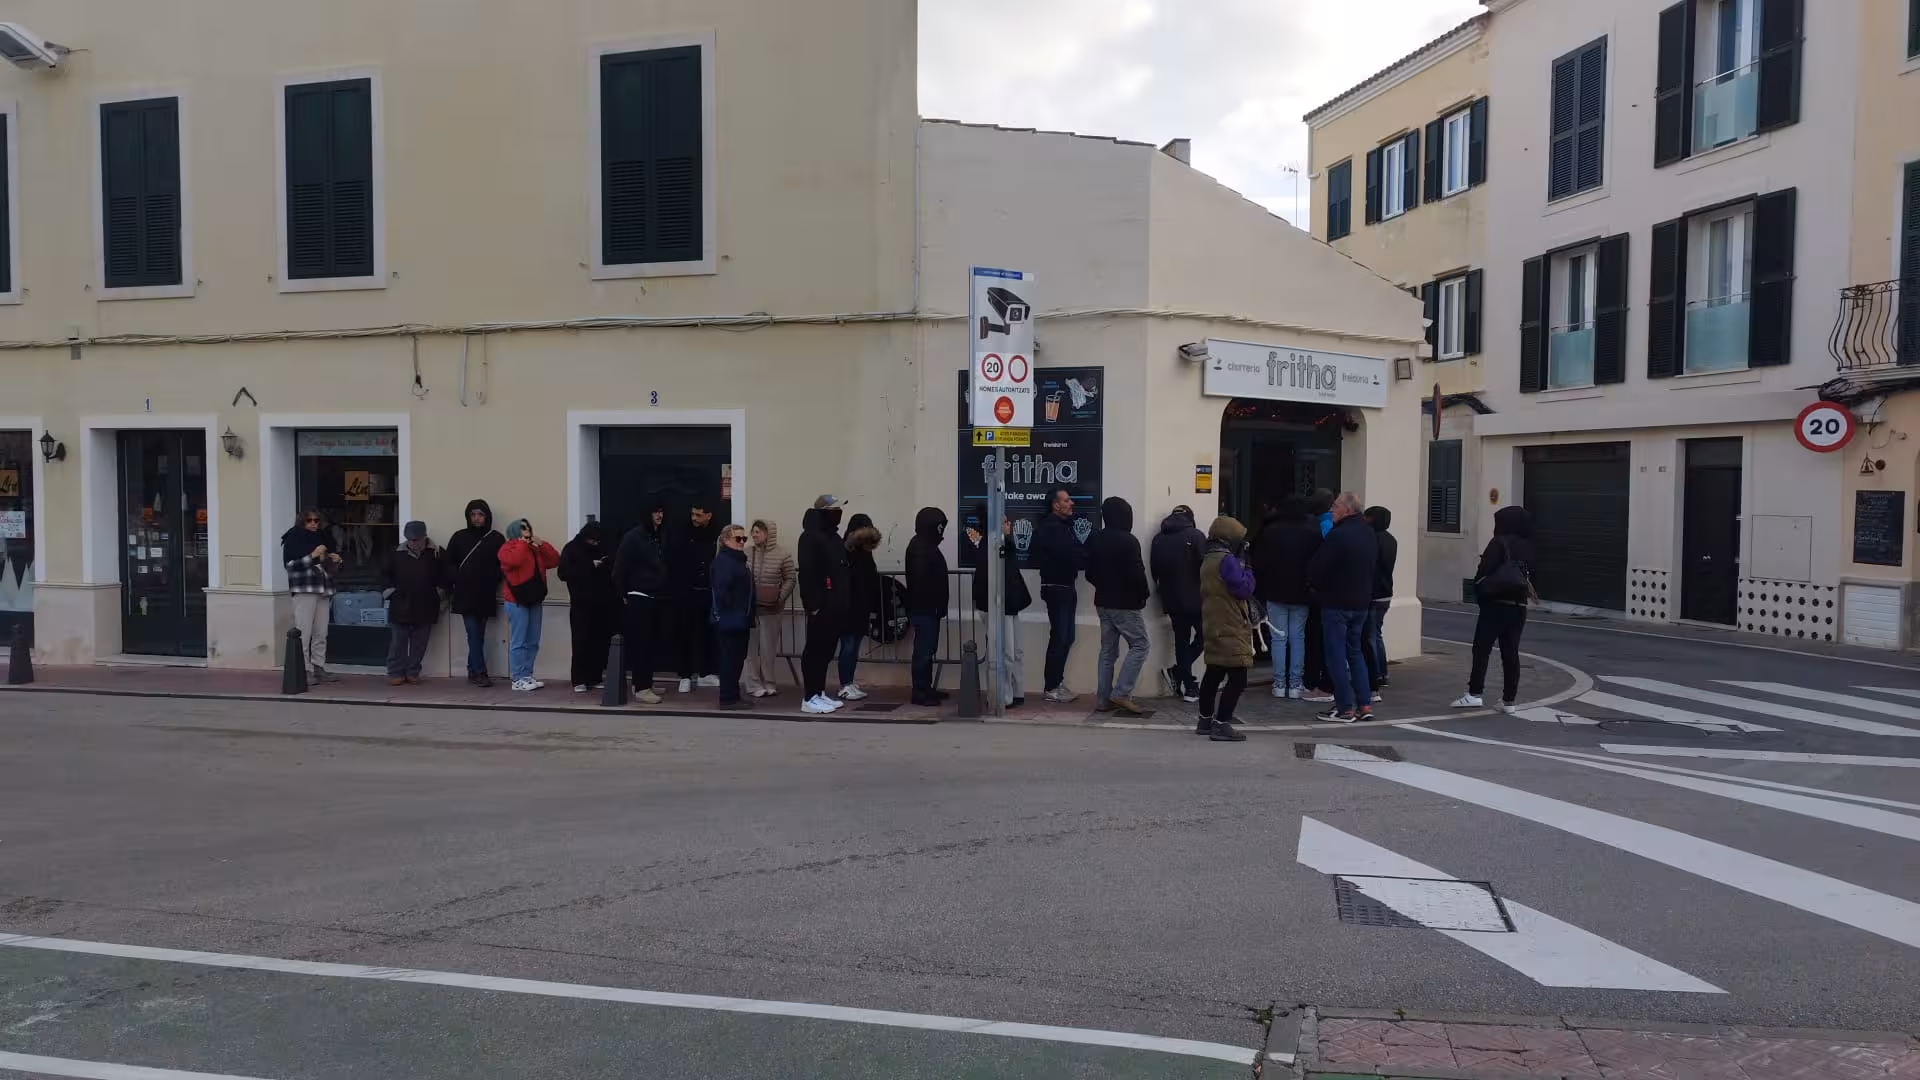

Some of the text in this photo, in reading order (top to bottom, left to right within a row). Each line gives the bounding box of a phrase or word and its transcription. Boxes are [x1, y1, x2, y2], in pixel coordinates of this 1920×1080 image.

[986, 362, 999, 373] 20
[1266, 351, 1337, 391] fritha
[146, 398, 151, 410] 1
[651, 390, 658, 405] 3
[1810, 418, 1840, 435] 20
[1004, 492, 1025, 500] take
